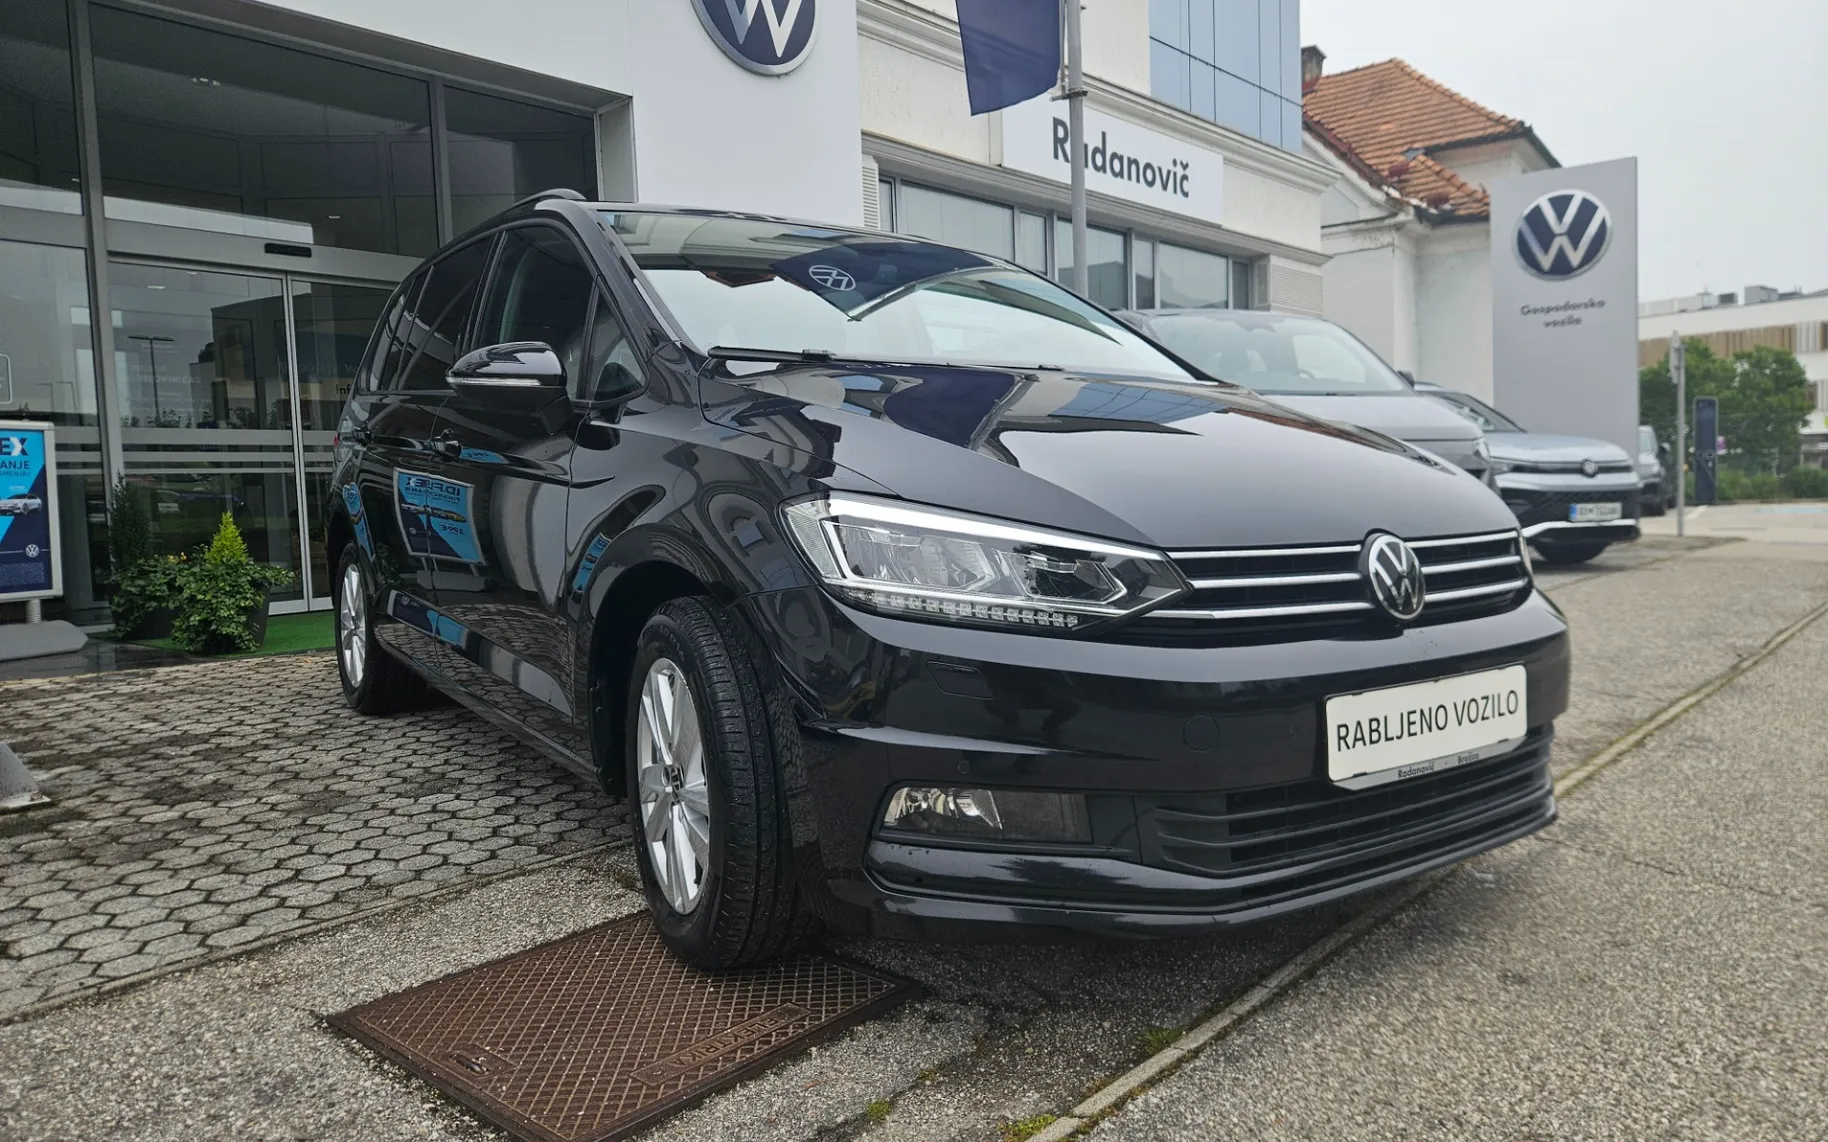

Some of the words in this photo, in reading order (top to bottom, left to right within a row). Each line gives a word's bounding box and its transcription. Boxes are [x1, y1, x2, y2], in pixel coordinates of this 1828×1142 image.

[1052, 116, 1190, 199] Rdanovič
[1336, 704, 1449, 752] RABLJENO
[1453, 690, 1519, 727] VOZILO
